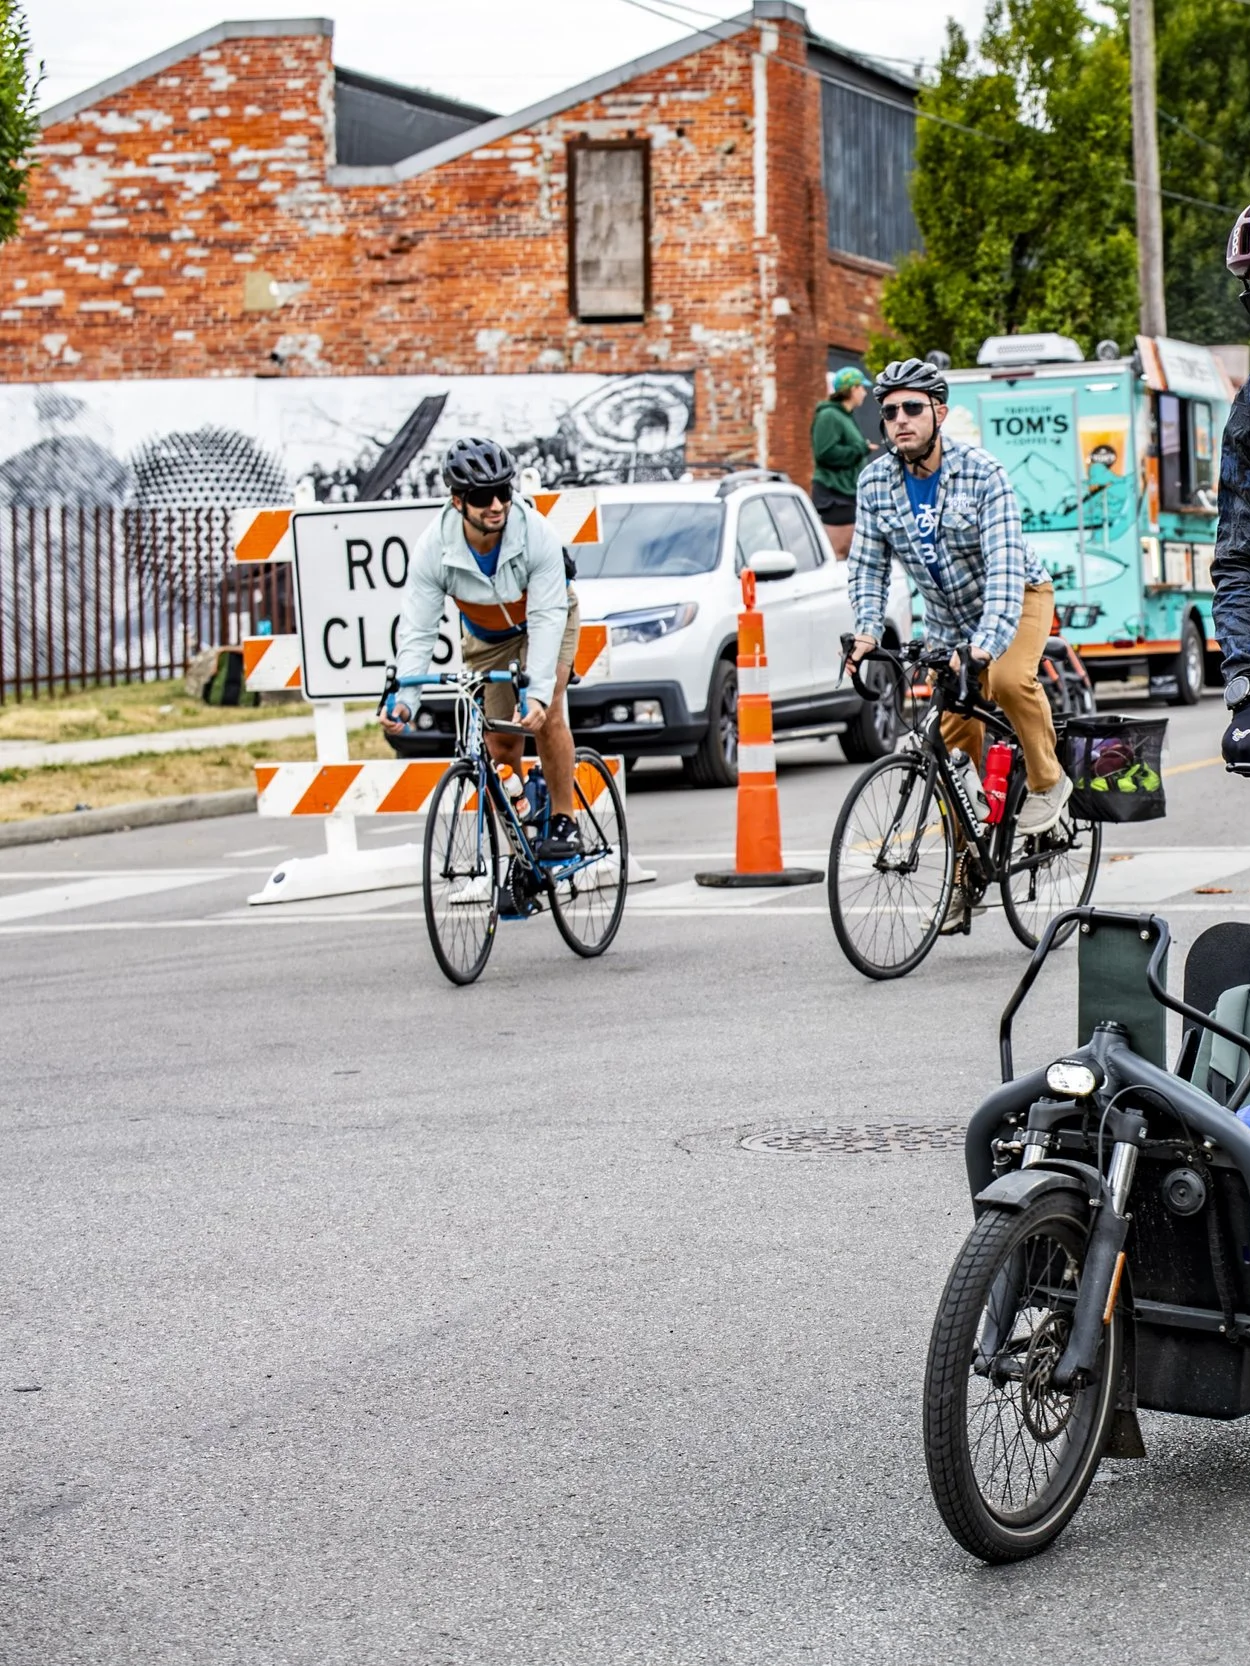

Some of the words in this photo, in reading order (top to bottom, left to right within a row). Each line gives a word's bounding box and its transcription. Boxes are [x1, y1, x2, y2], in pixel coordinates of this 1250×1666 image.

[990, 414, 1069, 437] TOM'S
[346, 536, 409, 590] RO
[323, 613, 465, 669] CLS
